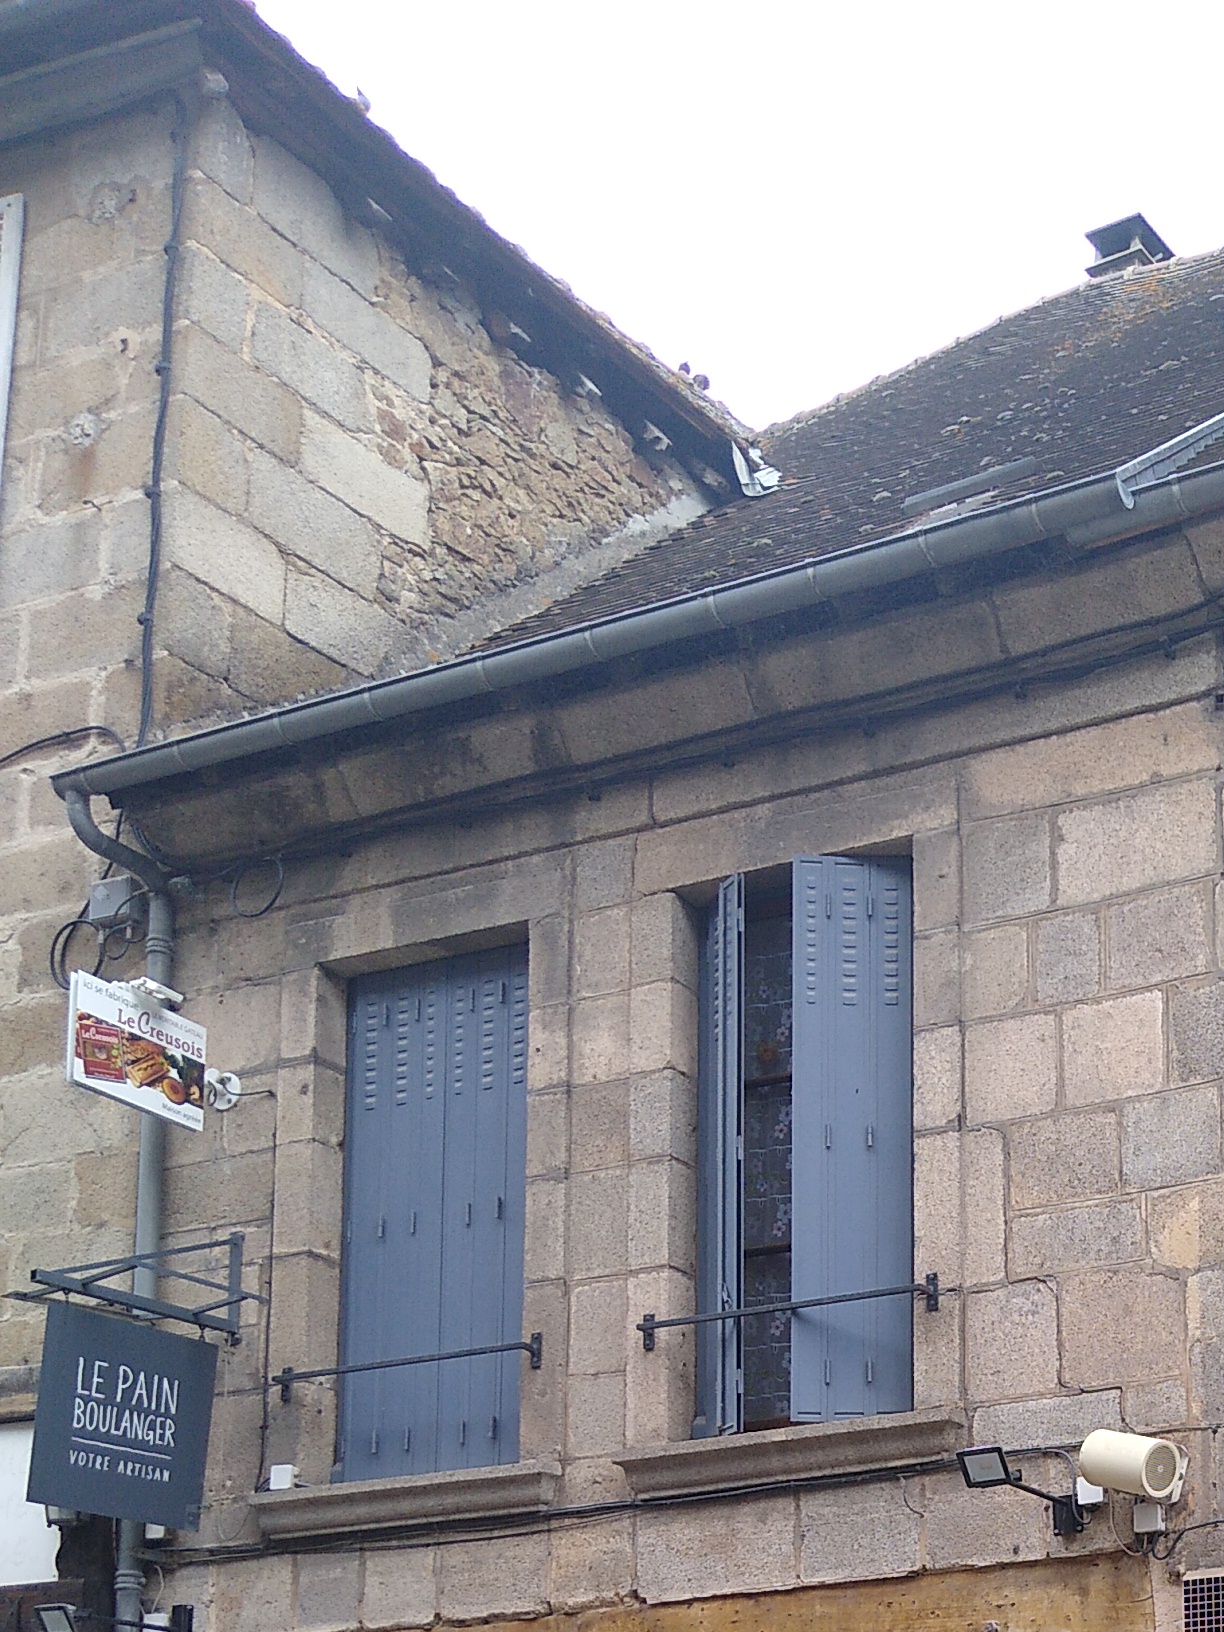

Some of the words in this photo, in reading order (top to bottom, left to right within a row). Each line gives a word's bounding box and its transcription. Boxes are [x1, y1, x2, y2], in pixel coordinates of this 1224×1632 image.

[95, 985, 103, 995] se
[105, 986, 139, 1011] fabrique
[138, 1011, 203, 1059] Creusois
[76, 1357, 110, 1399] LE
[116, 1366, 179, 1414] PAIN
[73, 1398, 176, 1447] BOULANGER
[69, 1450, 110, 1471] VOTRE
[117, 1460, 171, 1482] ARTISAN
